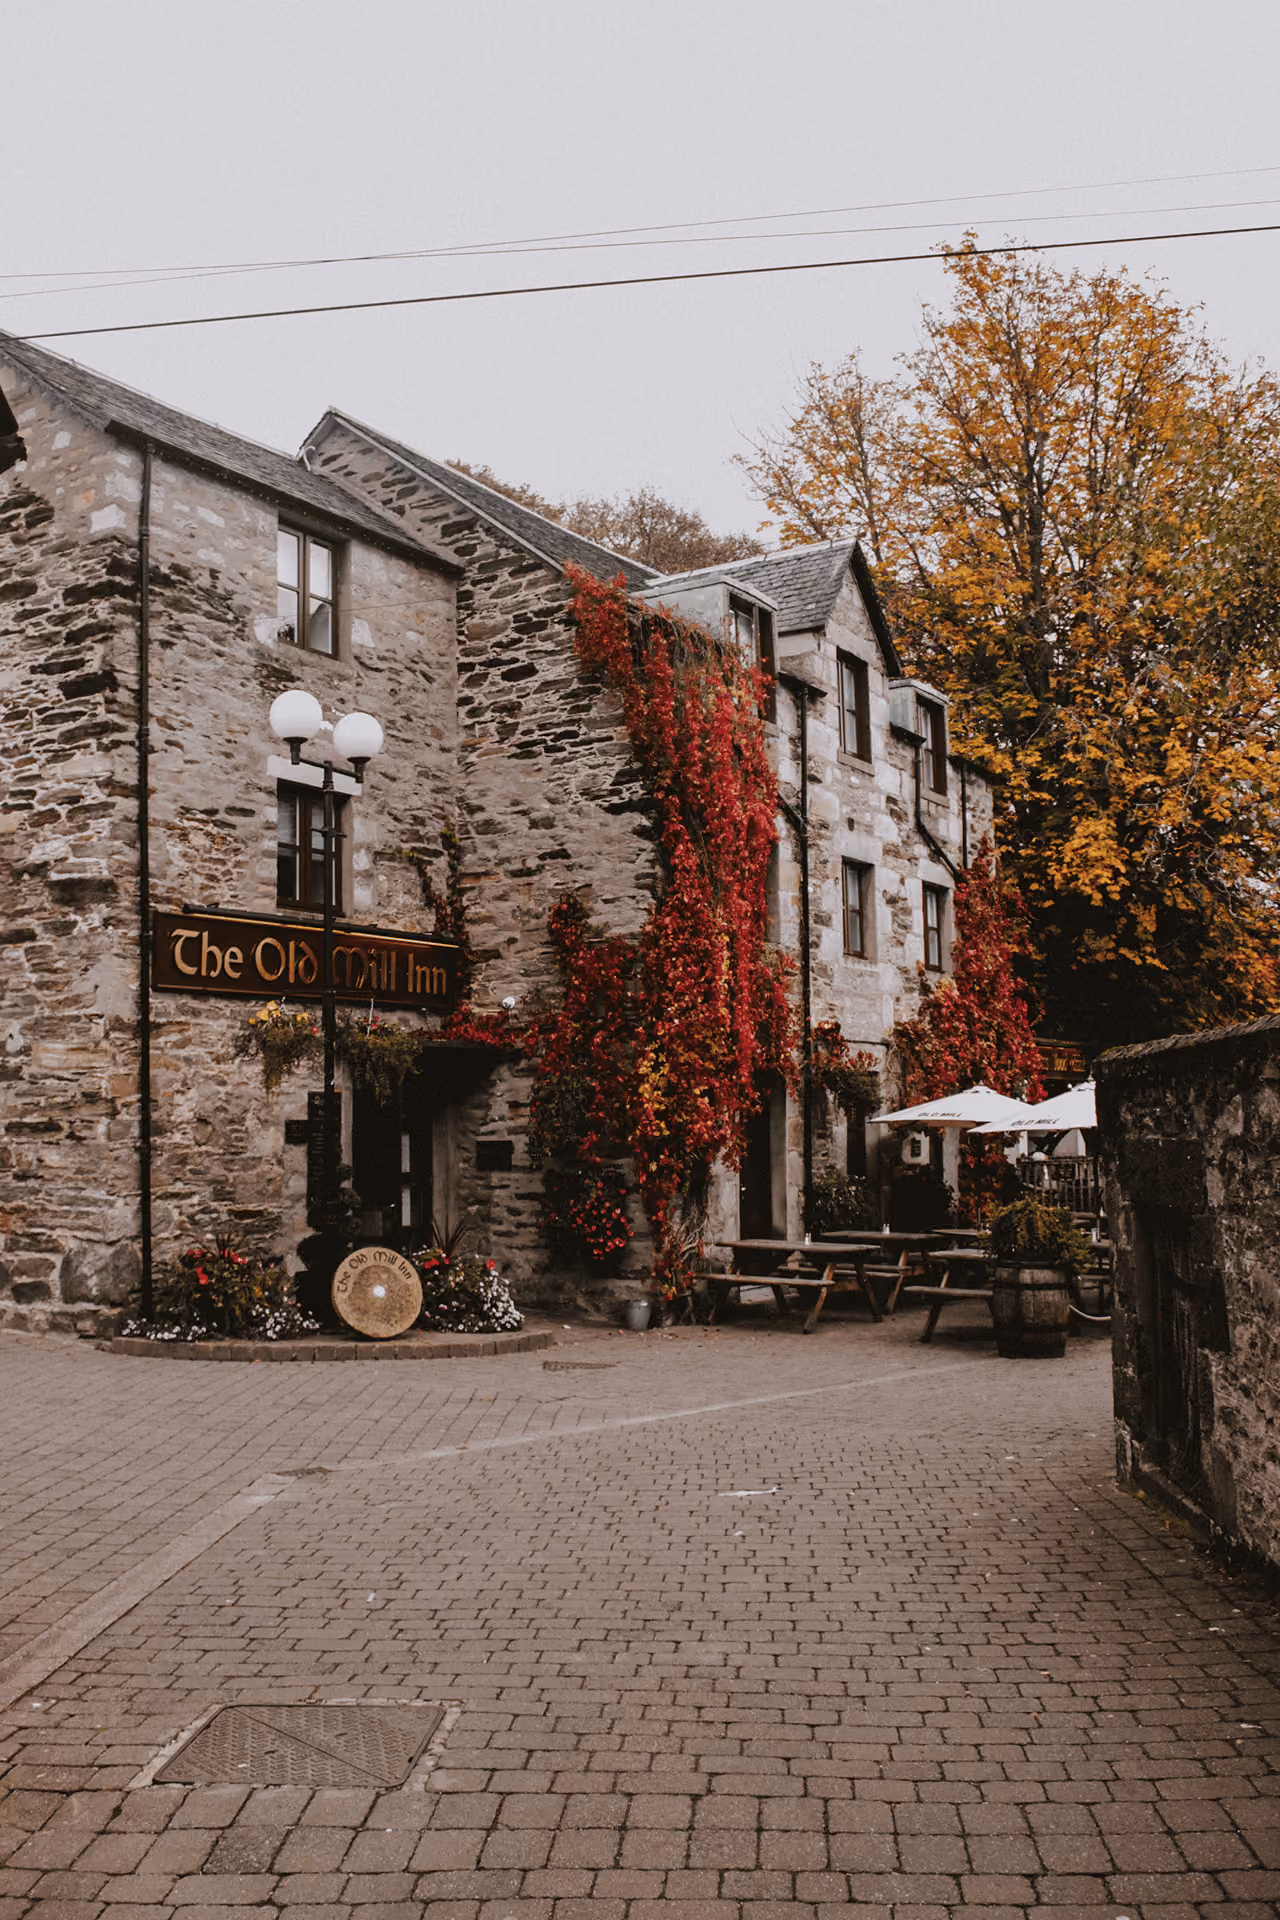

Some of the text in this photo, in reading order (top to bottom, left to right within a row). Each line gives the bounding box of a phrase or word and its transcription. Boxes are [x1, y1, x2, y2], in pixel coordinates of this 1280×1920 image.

[170, 928, 447, 995] The Old Mill Inn
[337, 1250, 412, 1293] The Old Mill Inn
